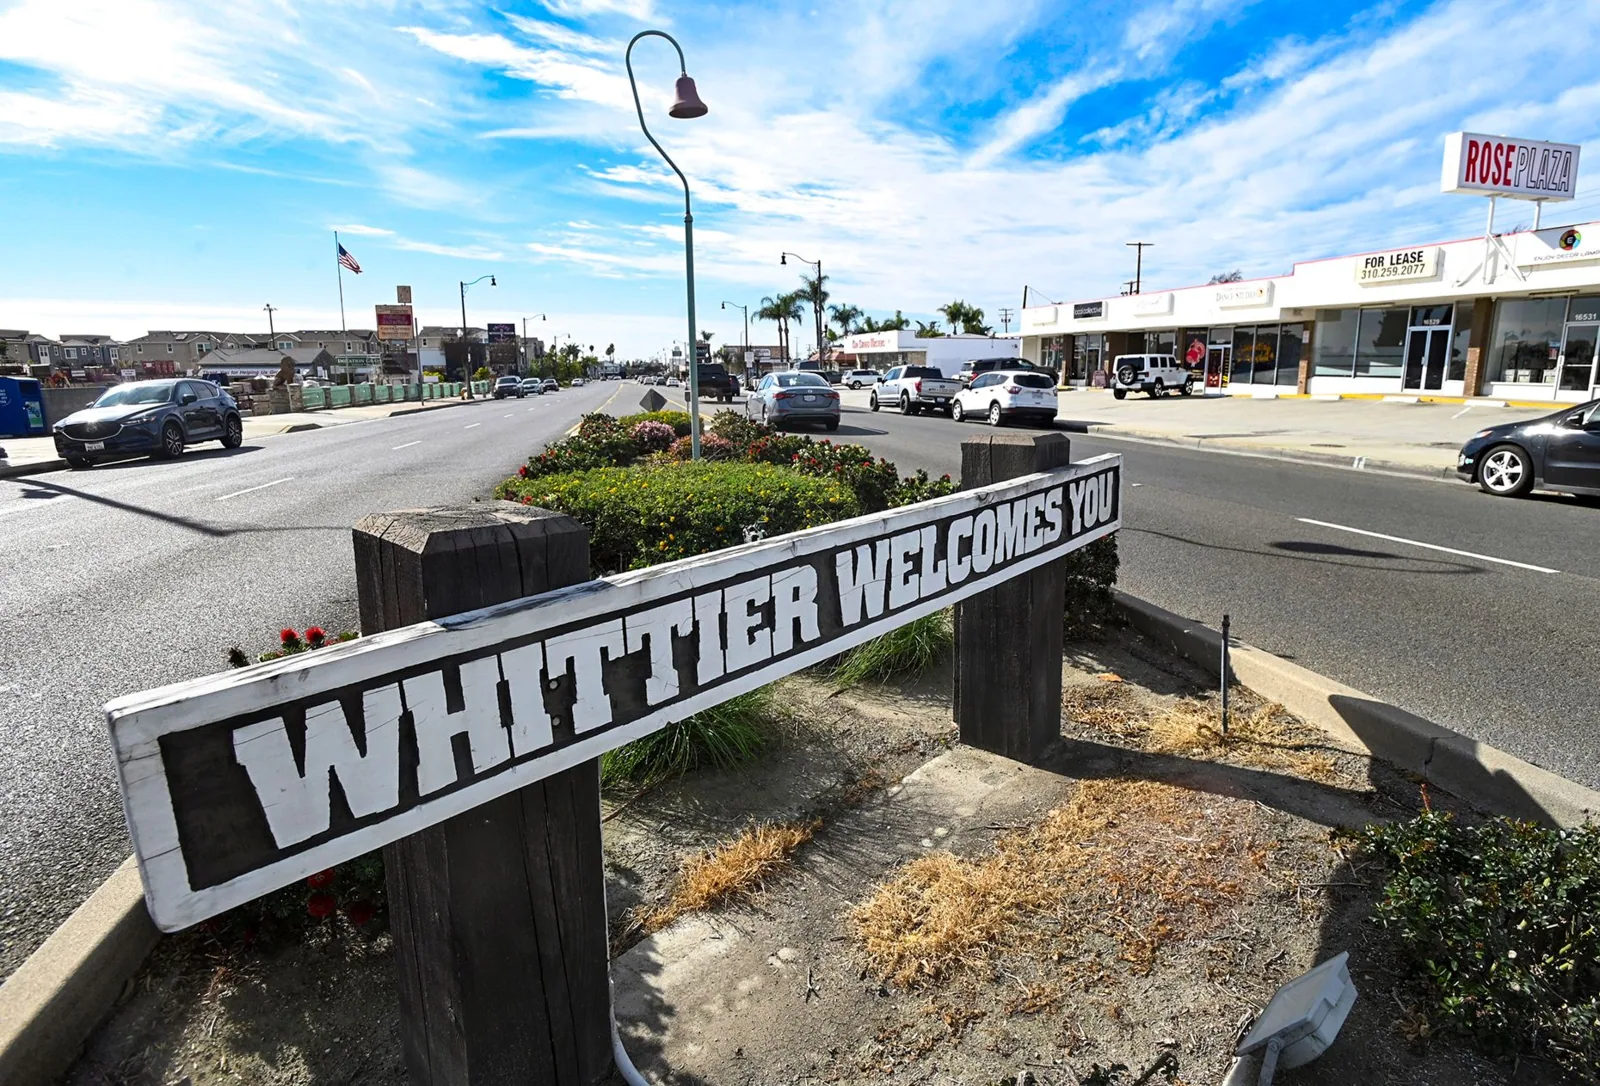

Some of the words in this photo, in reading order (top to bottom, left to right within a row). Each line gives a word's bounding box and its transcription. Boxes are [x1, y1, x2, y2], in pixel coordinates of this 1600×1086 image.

[1465, 140, 1516, 187] ROSE
[1514, 145, 1572, 192] PLAZA
[1365, 255, 1385, 269] FOR
[1390, 250, 1424, 266] LEASE
[1361, 263, 1426, 280] 310.259.2077
[1574, 313, 1597, 321] 16531
[233, 563, 821, 849] WHITTIER
[835, 486, 1063, 627] WELCOMES
[1069, 471, 1115, 535] YOU
